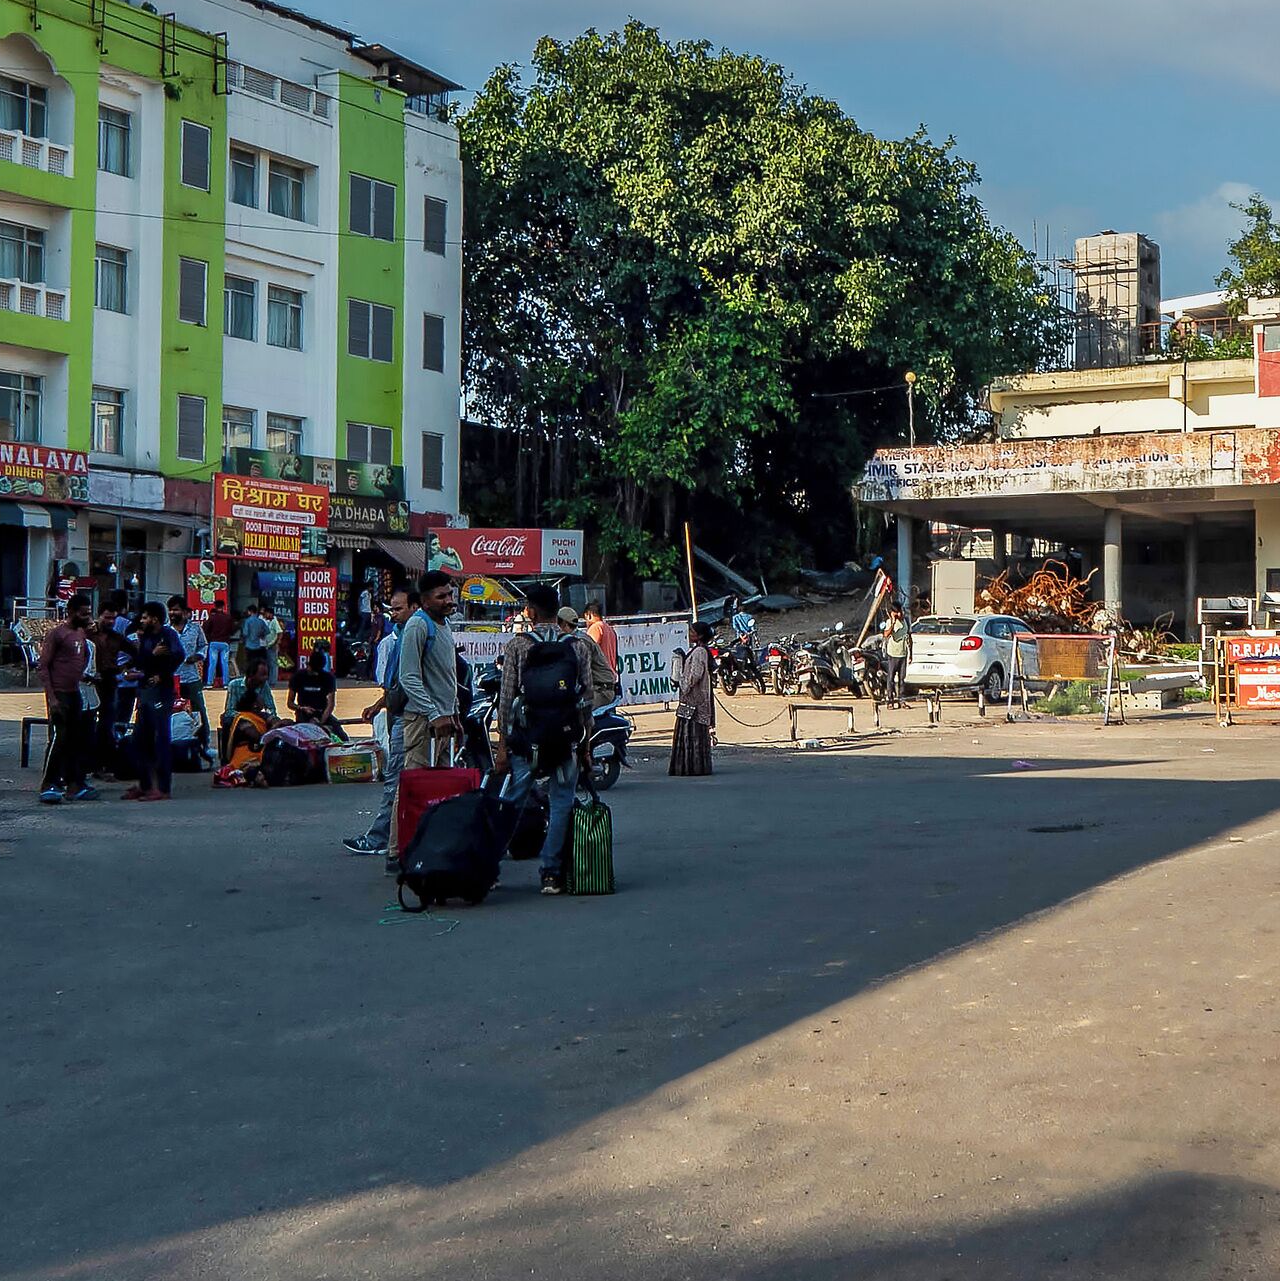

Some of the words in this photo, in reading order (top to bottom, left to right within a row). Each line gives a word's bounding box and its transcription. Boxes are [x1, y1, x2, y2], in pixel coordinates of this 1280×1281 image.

[4, 464, 45, 480] DINNER
[222, 478, 291, 508] विश्राम
[296, 493, 324, 512] घर
[346, 506, 385, 523] DHABA
[551, 538, 576, 547] PUCHI
[558, 548, 569, 556] DA
[549, 558, 577, 567] DHABA
[303, 571, 331, 584] DOOR
[299, 586, 336, 599] MITORY
[304, 602, 330, 615] BEDS
[300, 617, 334, 632] CLOCK
